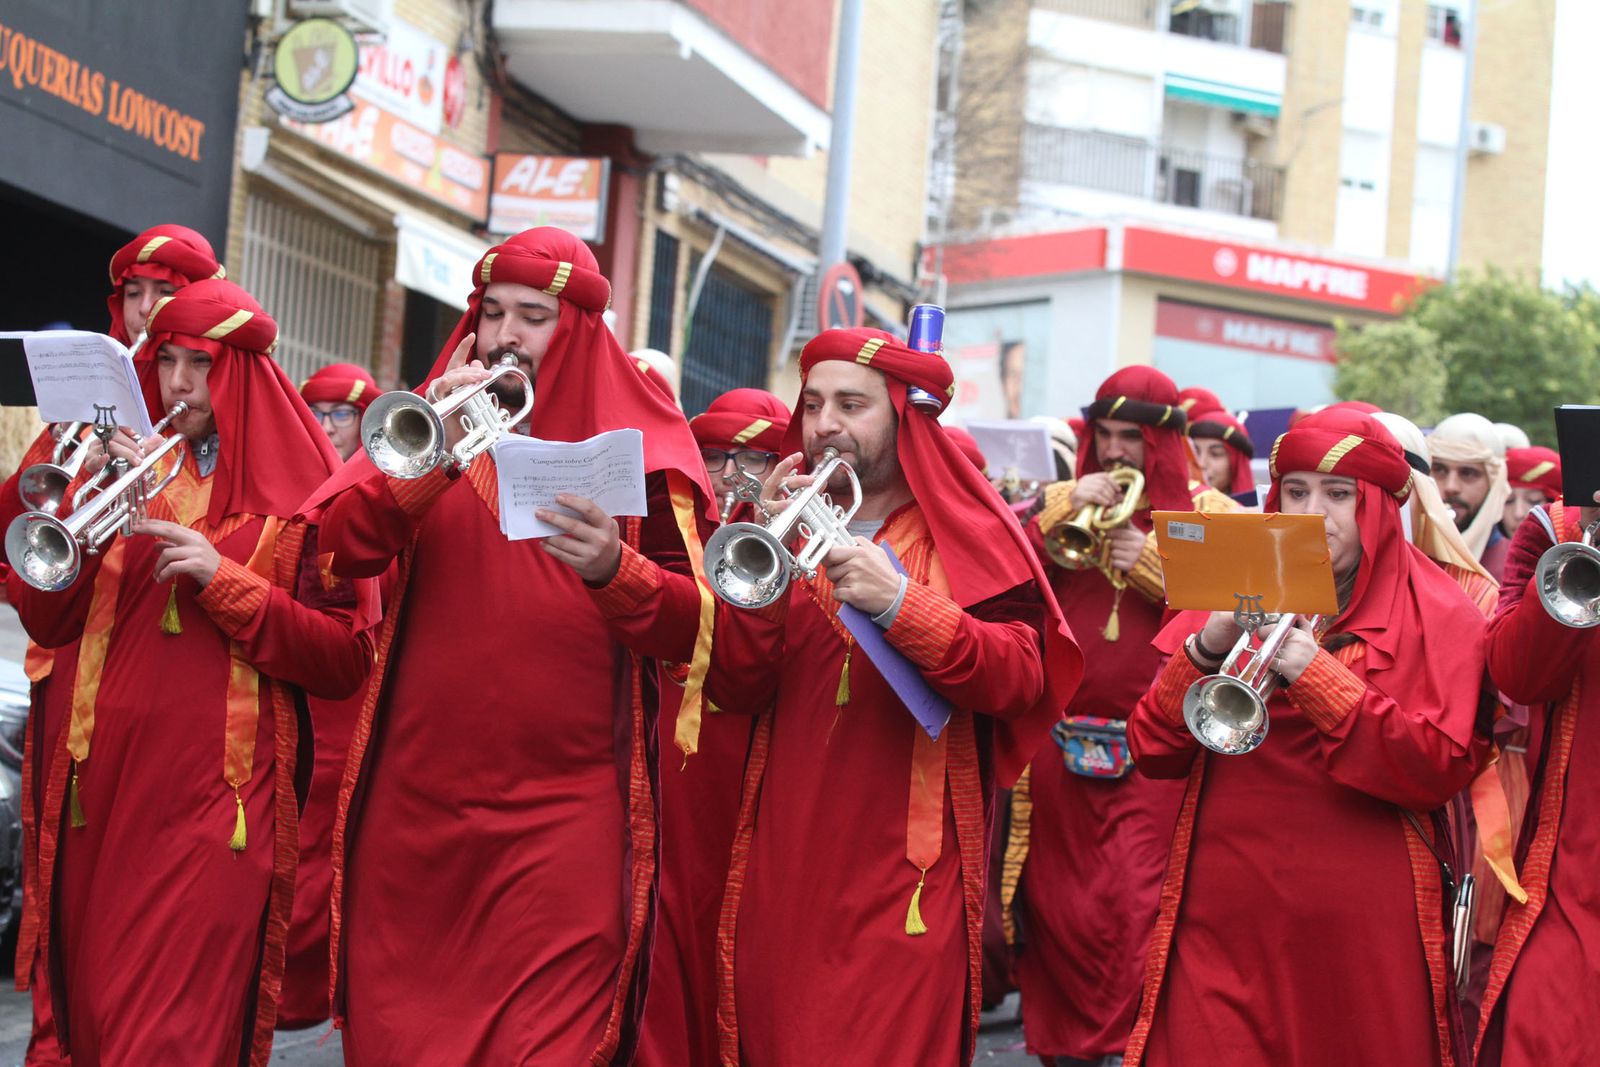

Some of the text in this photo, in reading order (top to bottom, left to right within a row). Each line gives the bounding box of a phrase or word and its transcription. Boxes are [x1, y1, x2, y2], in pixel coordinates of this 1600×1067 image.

[107, 80, 205, 161] LOWCOST
[501, 155, 588, 196] ALE
[1247, 253, 1369, 300] MAPFRE
[1223, 319, 1320, 355] MAPFRE
